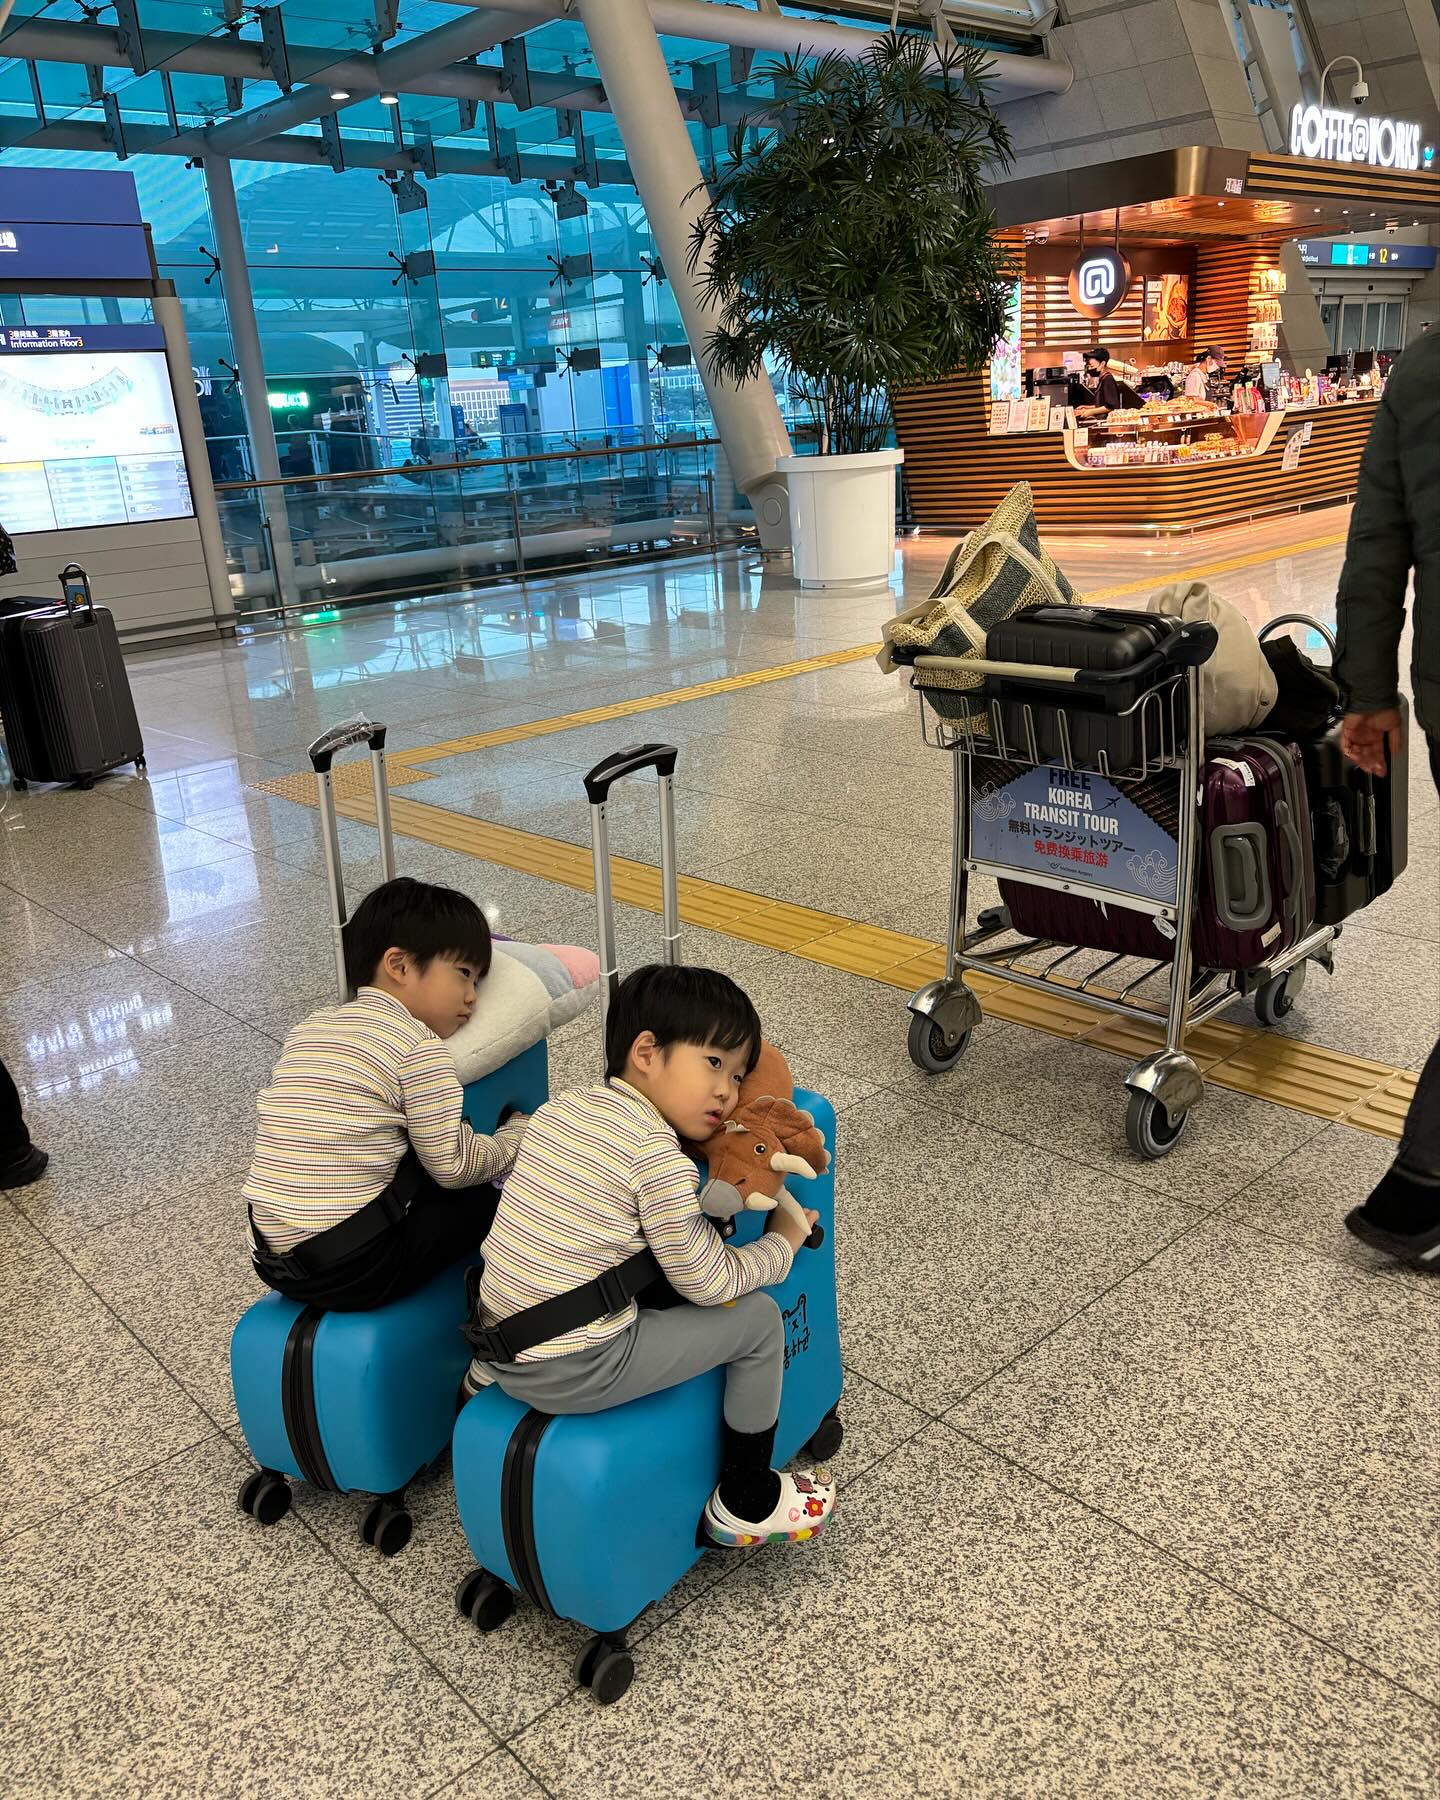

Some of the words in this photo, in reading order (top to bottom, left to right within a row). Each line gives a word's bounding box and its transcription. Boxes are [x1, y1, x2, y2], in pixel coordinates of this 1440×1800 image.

[1290, 103, 1420, 170] COFFEE@WORKS
[1379, 247, 1388, 264] 12
[11, 339, 59, 349] Information
[1050, 768, 1091, 791] FREE
[1048, 787, 1093, 811] KOREA
[1023, 802, 1080, 828] TRANSIT
[1084, 813, 1119, 836] TOUR
[1008, 820, 1136, 853] 無料トランジットツアー
